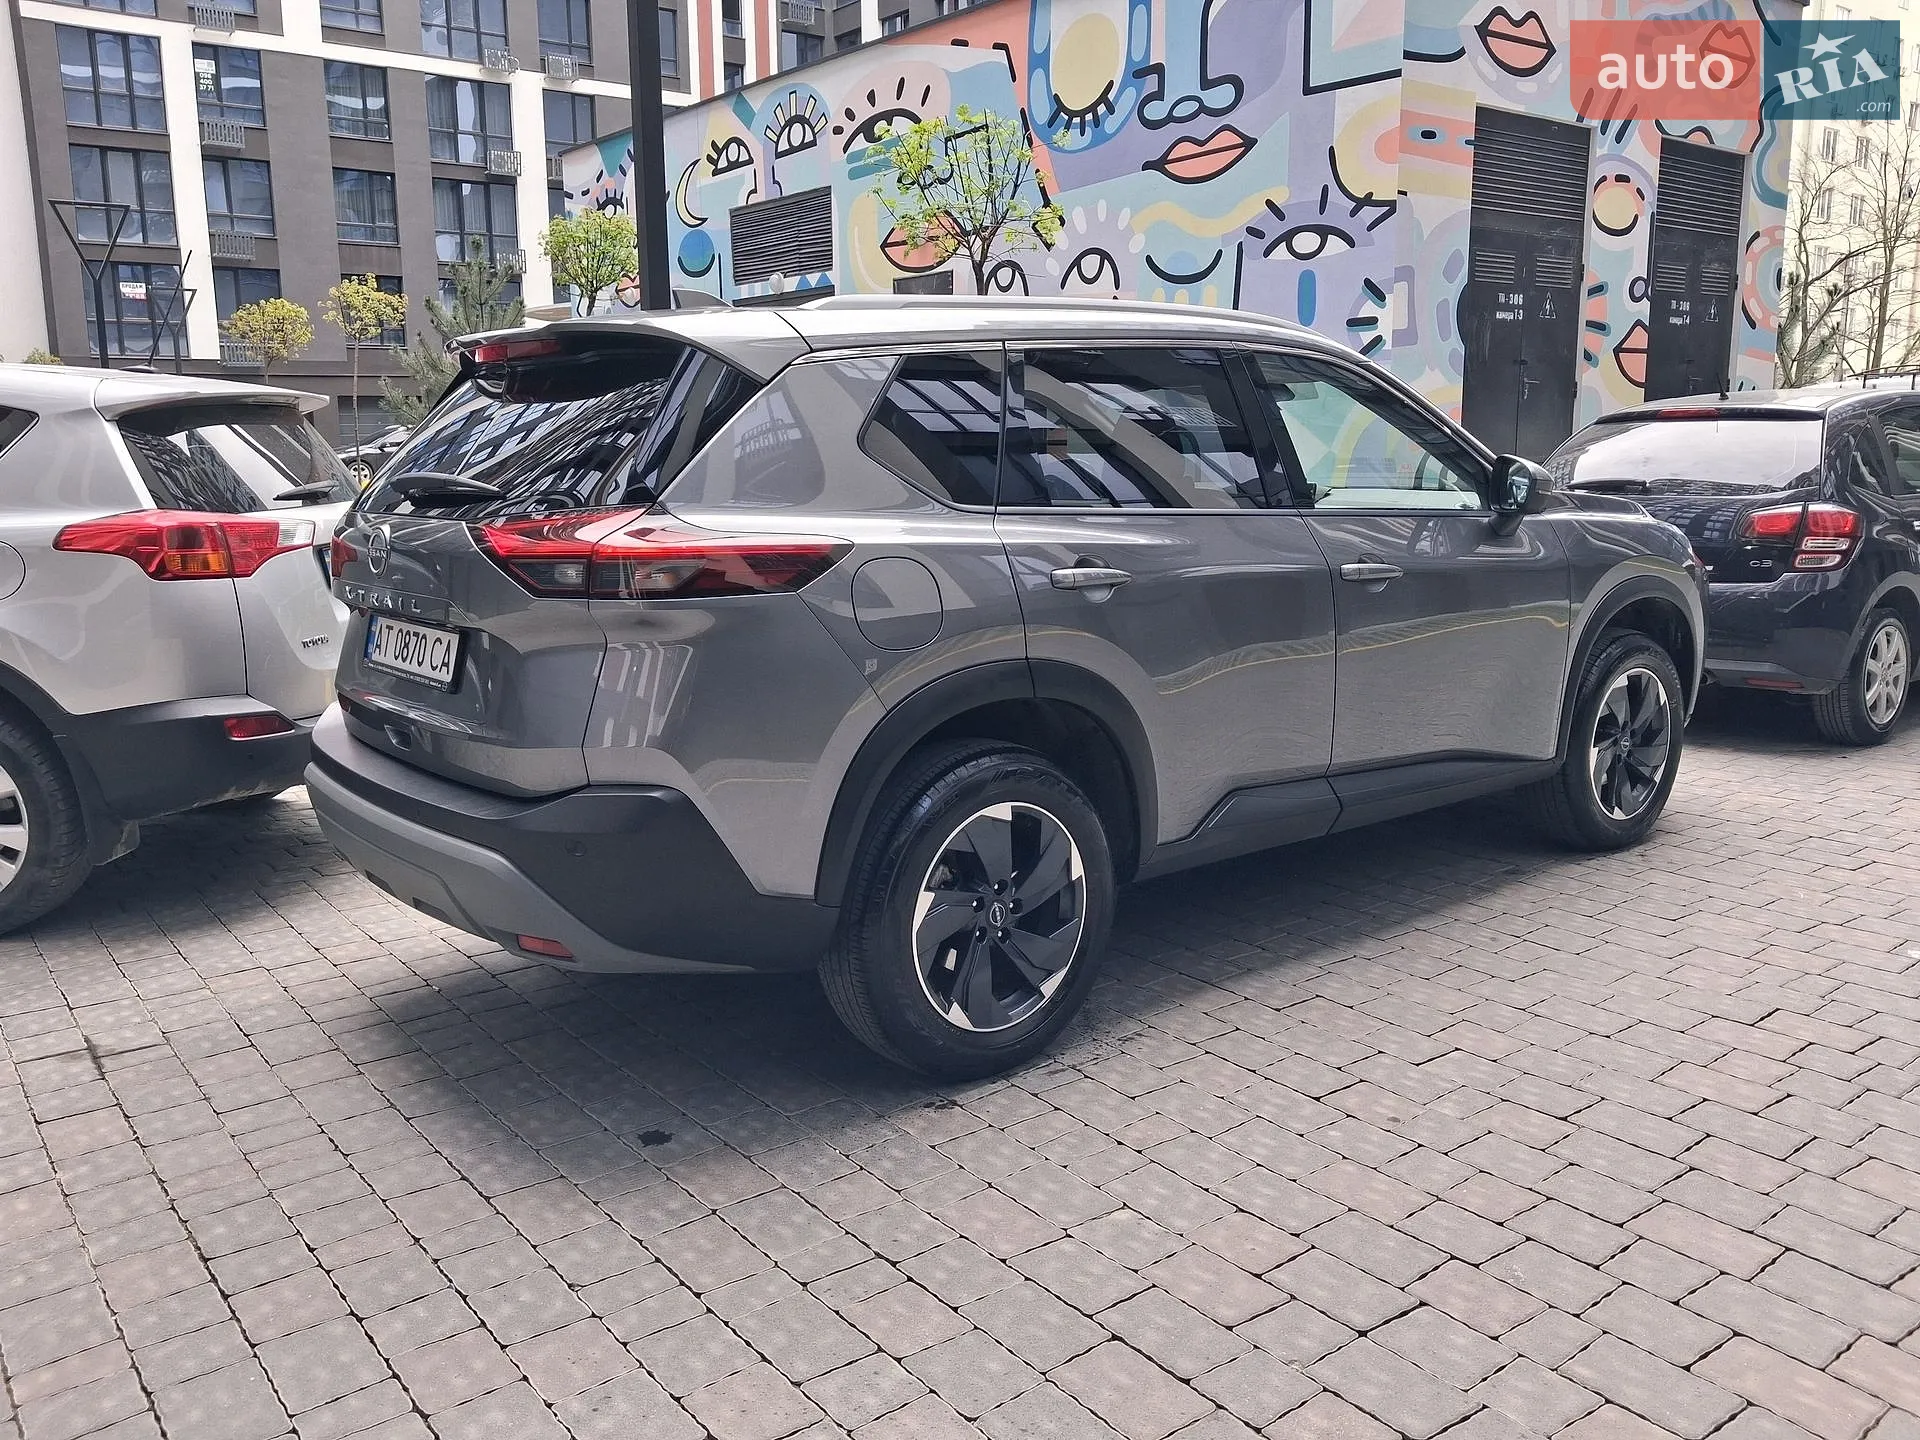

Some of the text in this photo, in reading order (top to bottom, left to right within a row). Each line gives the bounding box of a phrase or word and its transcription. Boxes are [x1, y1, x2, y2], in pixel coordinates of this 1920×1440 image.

[301, 634, 329, 649] TOYOTA
[374, 623, 394, 657] AT
[394, 627, 428, 668] 0870
[430, 636, 452, 676] CA
